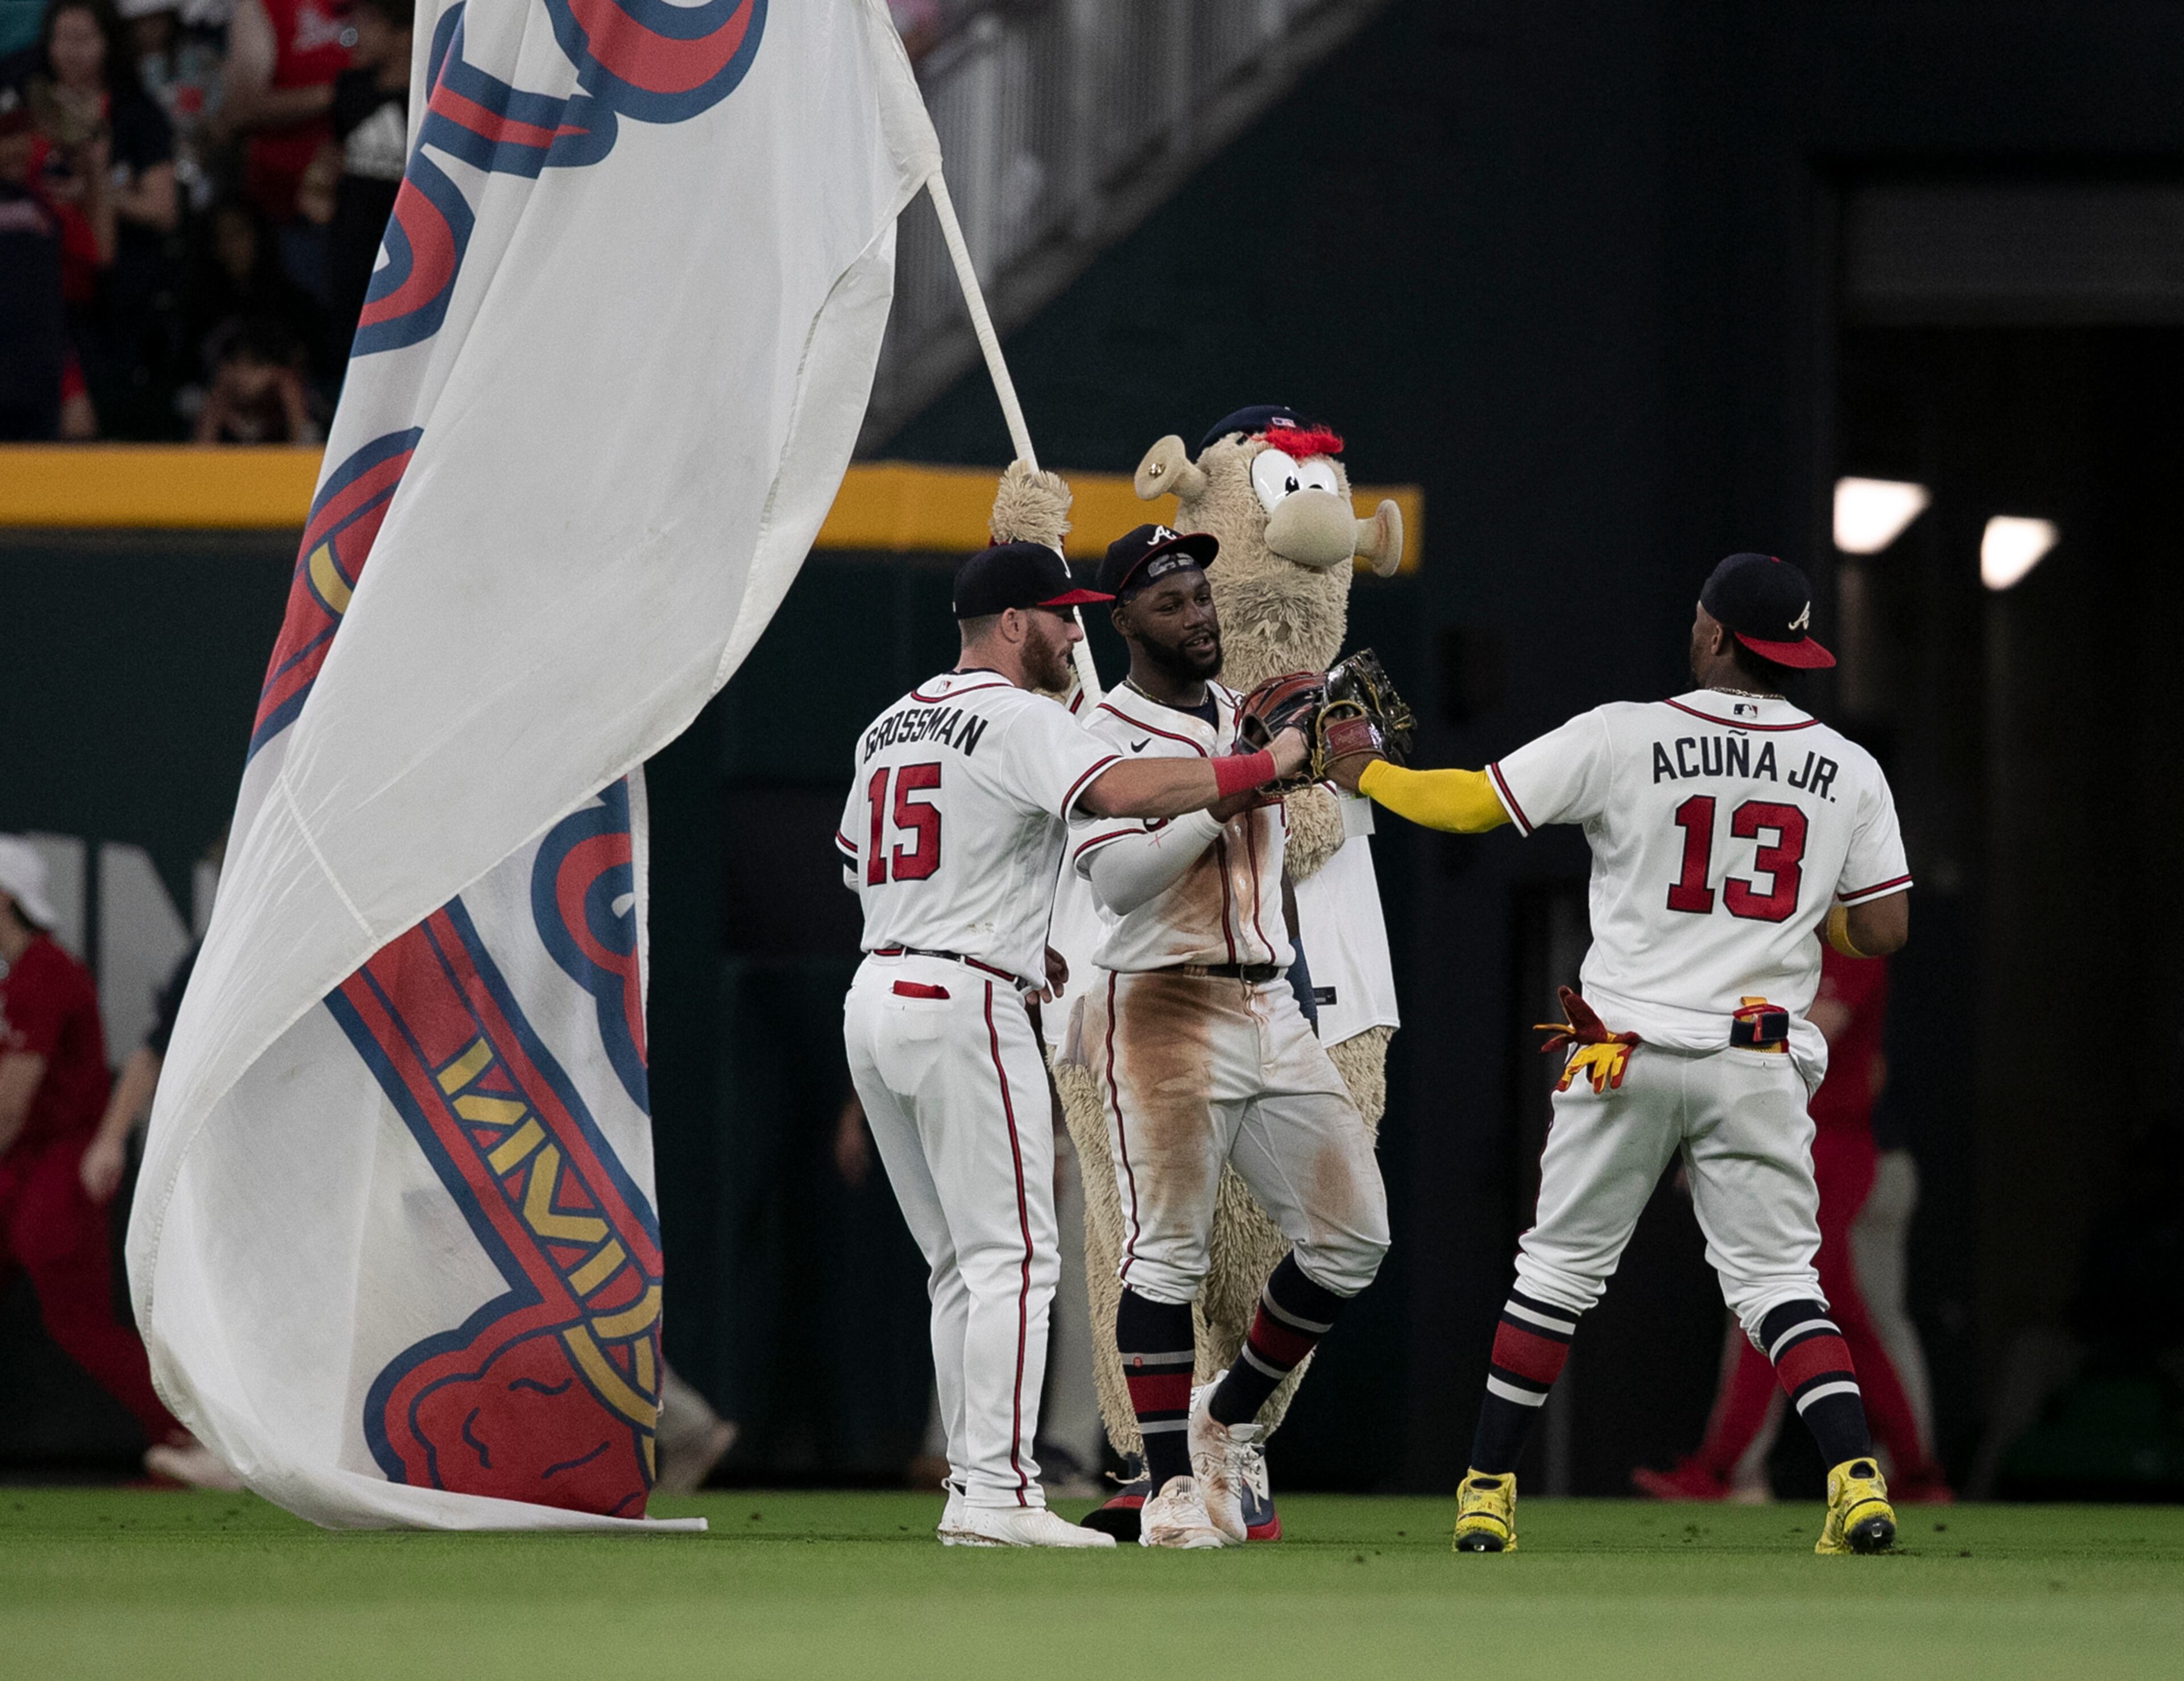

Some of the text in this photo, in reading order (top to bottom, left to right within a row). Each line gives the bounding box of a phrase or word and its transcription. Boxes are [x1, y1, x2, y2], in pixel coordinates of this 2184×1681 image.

[1147, 524, 1177, 546] A
[1788, 600, 1810, 631] A
[863, 707, 988, 765] GROSSMAN
[1653, 729, 1839, 804] ACUÑA JR.
[867, 761, 942, 887] 15
[1666, 794, 1809, 923] 13
